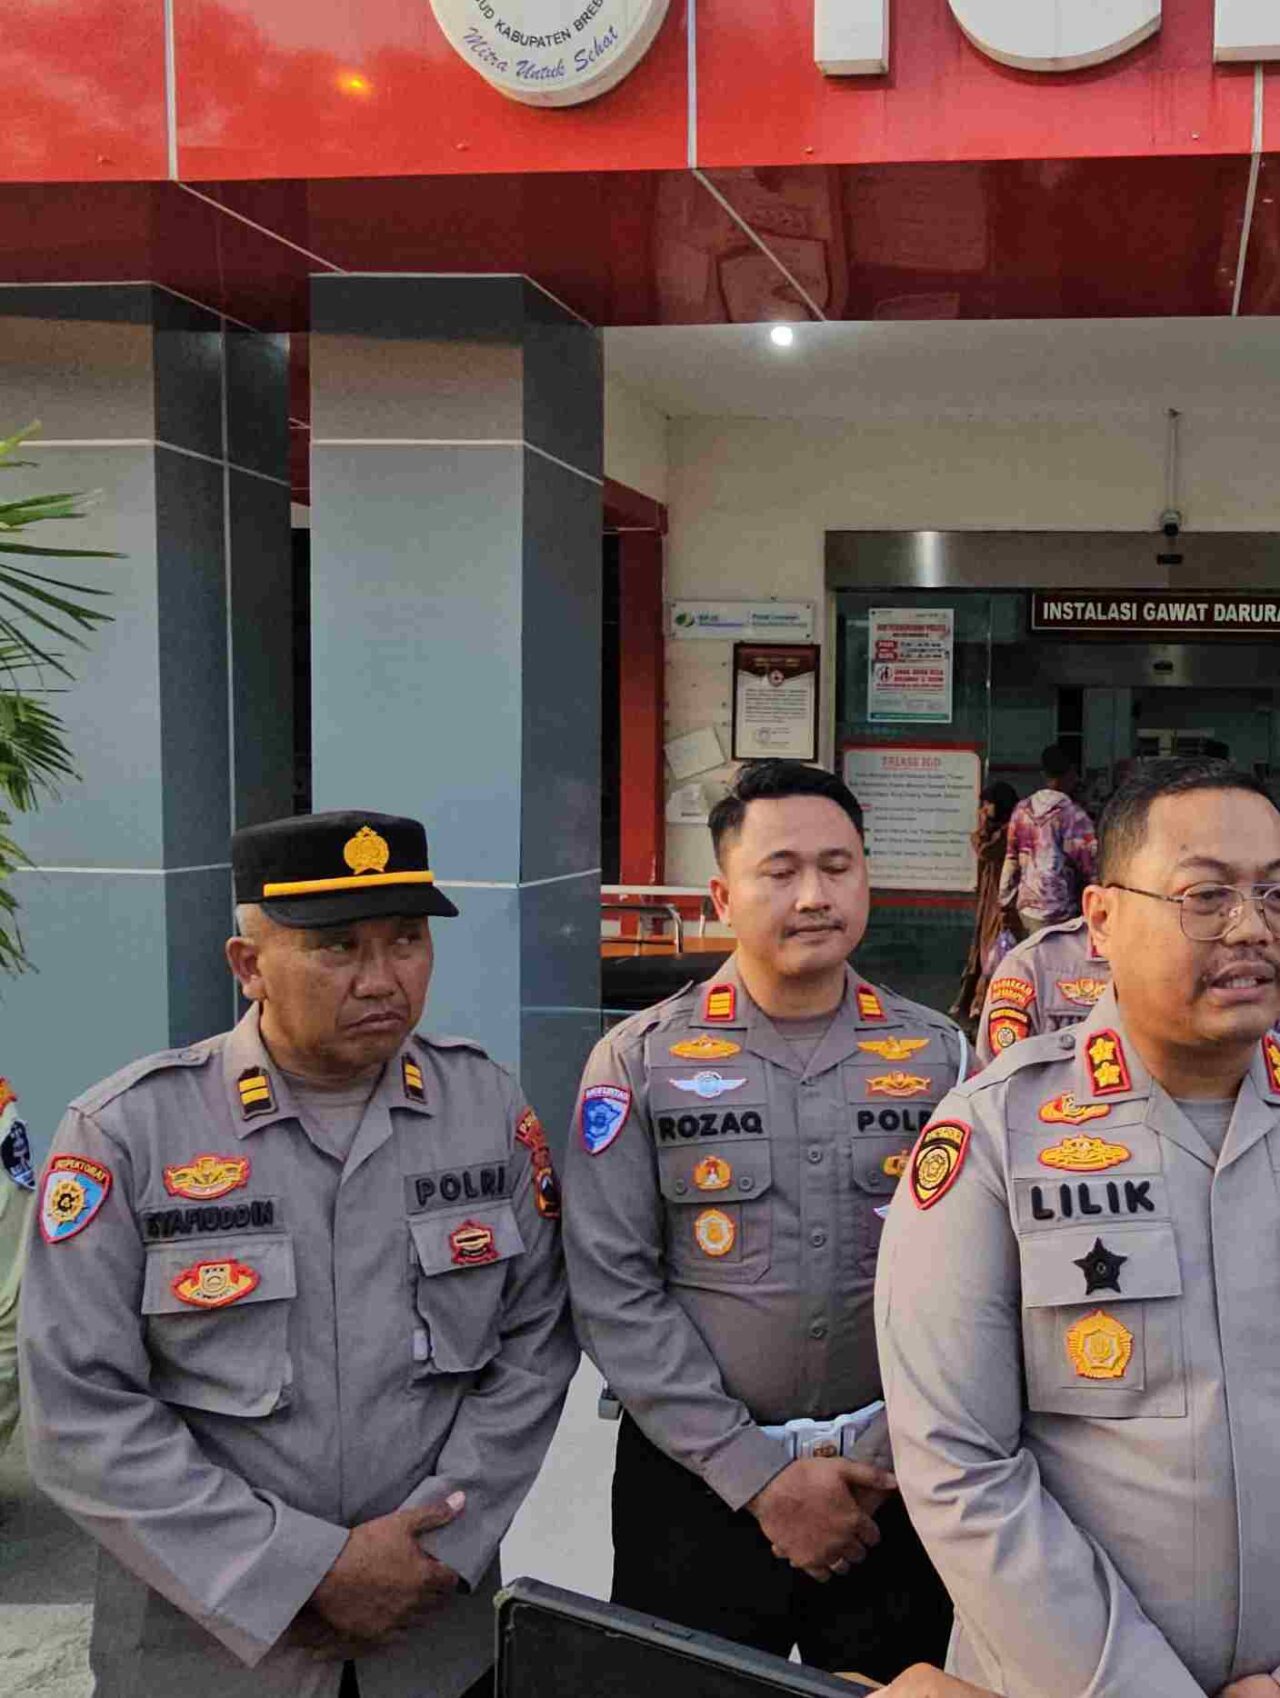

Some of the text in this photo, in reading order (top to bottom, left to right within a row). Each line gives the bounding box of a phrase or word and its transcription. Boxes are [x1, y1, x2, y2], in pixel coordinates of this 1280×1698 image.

[494, 19, 572, 48] KABUPATEN
[463, 27, 508, 73] Mitra
[515, 58, 566, 80] Untuk
[1043, 602, 1137, 620] INSTALASI
[1143, 602, 1208, 621] GAWAT
[657, 1111, 763, 1141] ROZAQ
[416, 1166, 506, 1207] POLRI
[1031, 1180, 1155, 1220] LILIK
